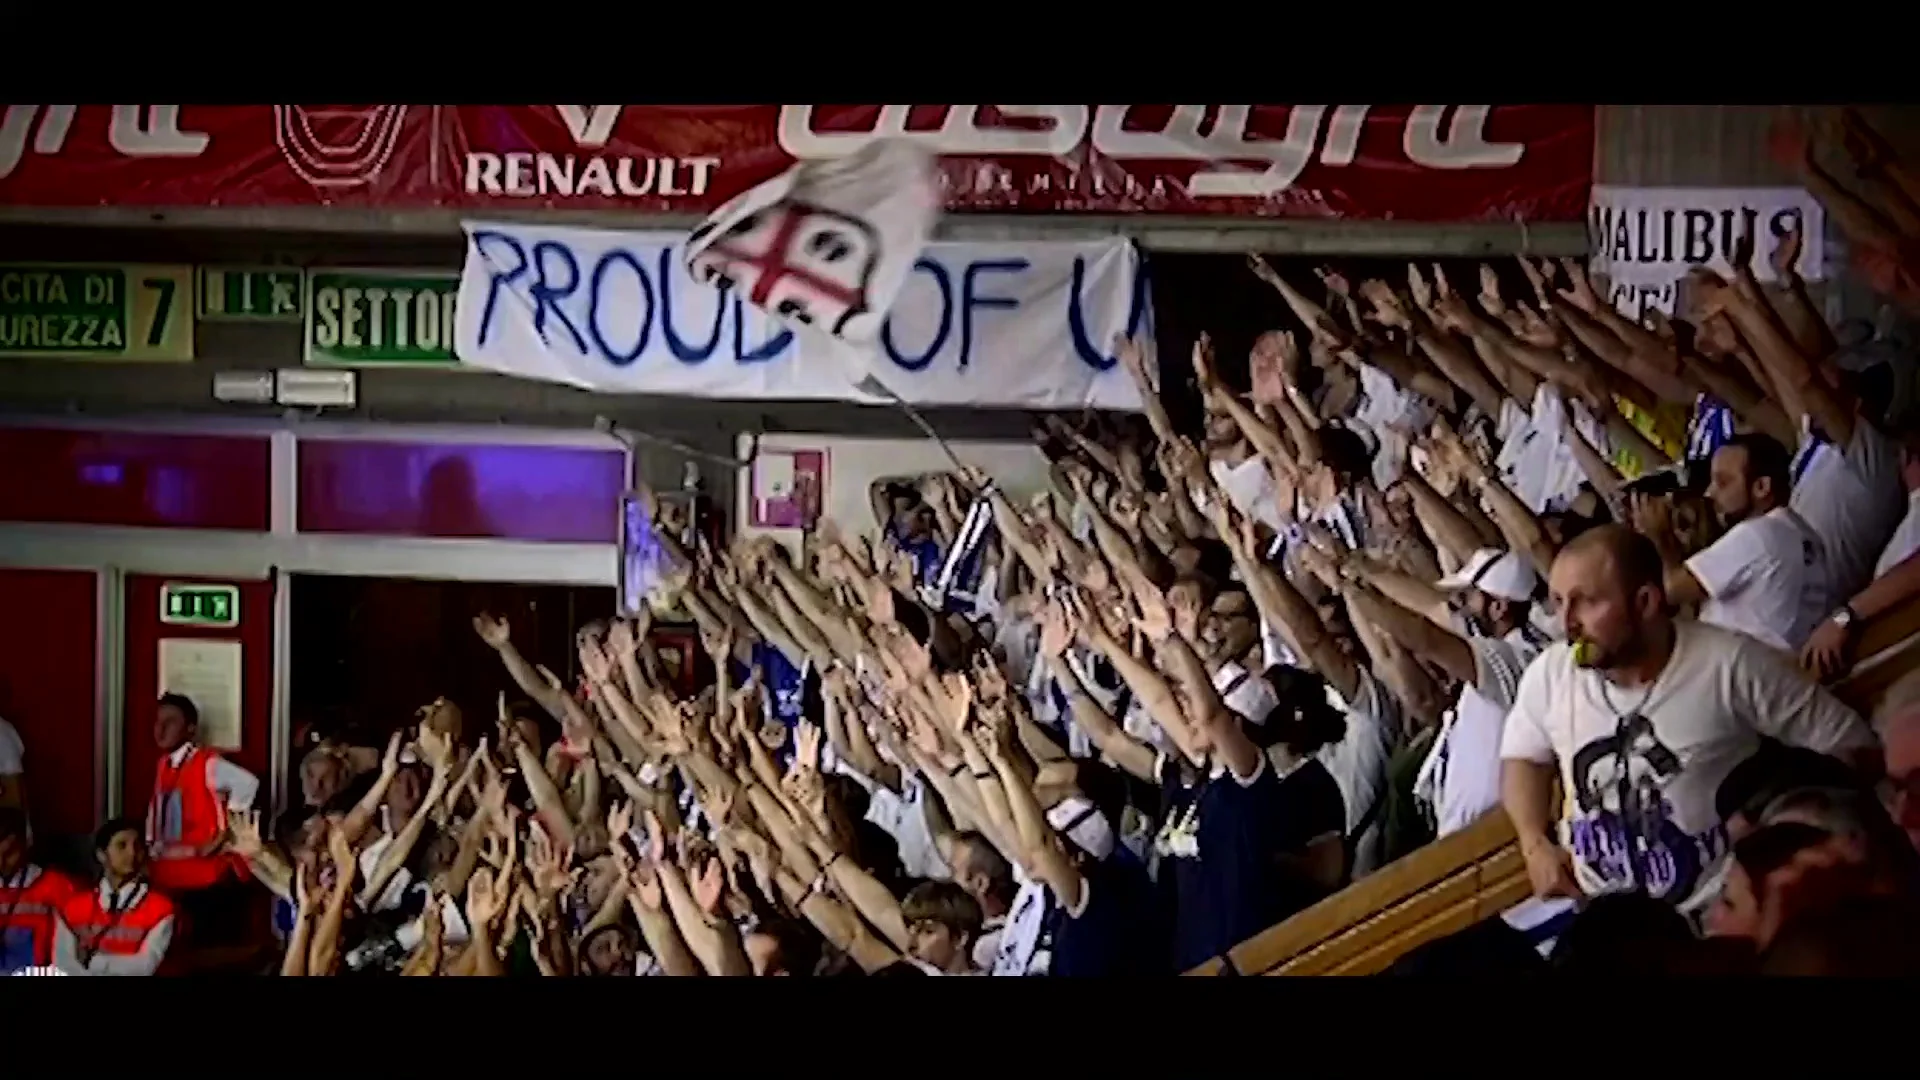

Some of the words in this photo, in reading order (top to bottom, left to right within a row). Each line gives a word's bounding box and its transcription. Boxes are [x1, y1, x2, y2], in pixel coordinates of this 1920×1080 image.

[465, 151, 720, 197] RENAULT
[2, 272, 68, 305] CITA
[85, 275, 114, 305] DI
[0, 314, 122, 347] UREZZA
[143, 278, 175, 346] 7
[878, 256, 1031, 371] OF
